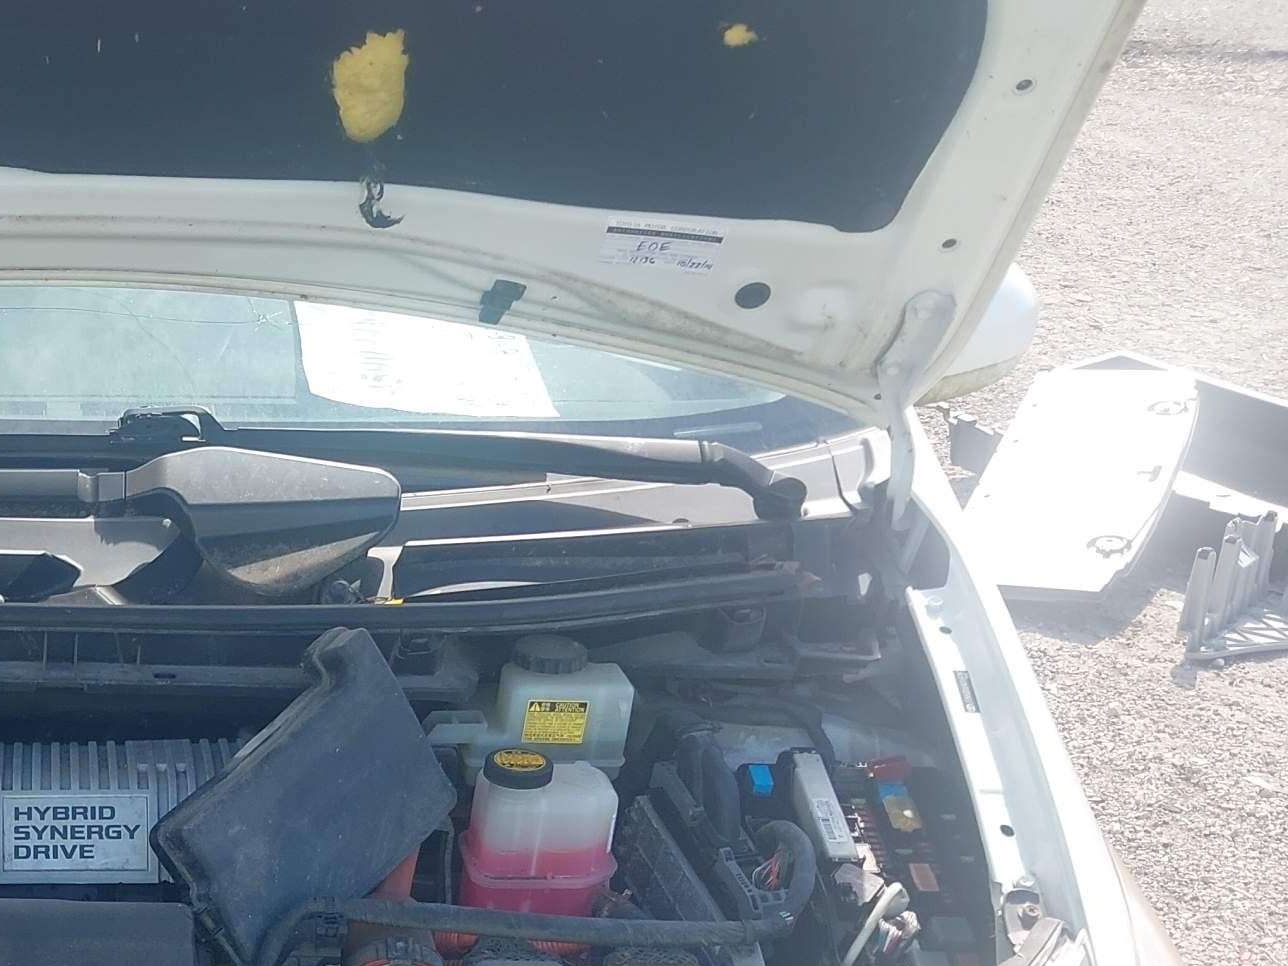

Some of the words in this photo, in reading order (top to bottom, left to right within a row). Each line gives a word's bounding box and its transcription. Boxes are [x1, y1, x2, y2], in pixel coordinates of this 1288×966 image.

[14, 806, 116, 821] HYBRID
[14, 824, 141, 840] SYNERGY
[14, 844, 95, 859] DRIVE
